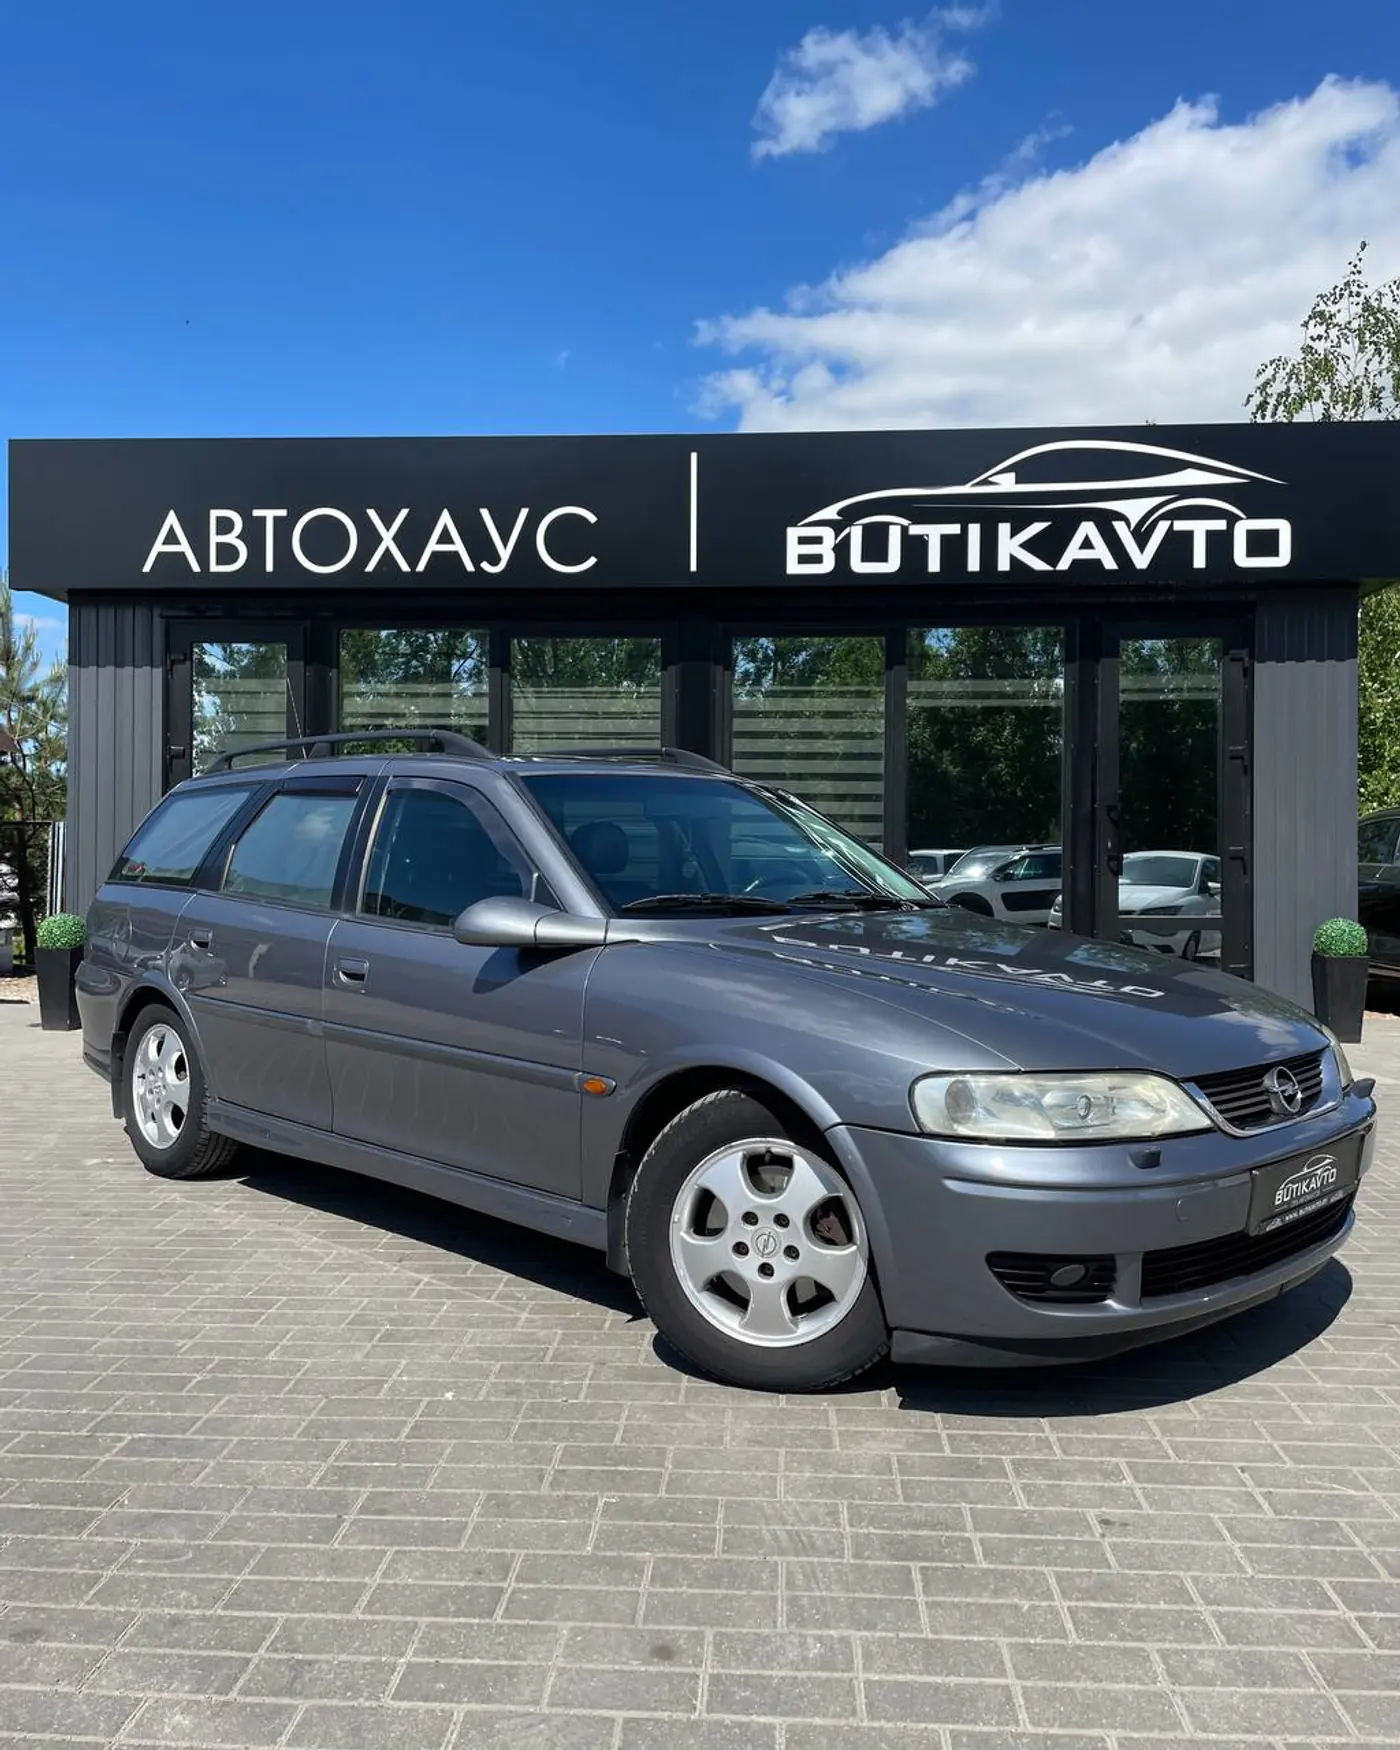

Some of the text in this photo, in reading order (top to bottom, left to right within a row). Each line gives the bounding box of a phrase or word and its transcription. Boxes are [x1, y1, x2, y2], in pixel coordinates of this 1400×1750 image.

[142, 505, 599, 574] АВТОХАУС
[786, 518, 1292, 574] BUTIKAVTO
[1274, 1168, 1337, 1206] BUTIKAVTO
